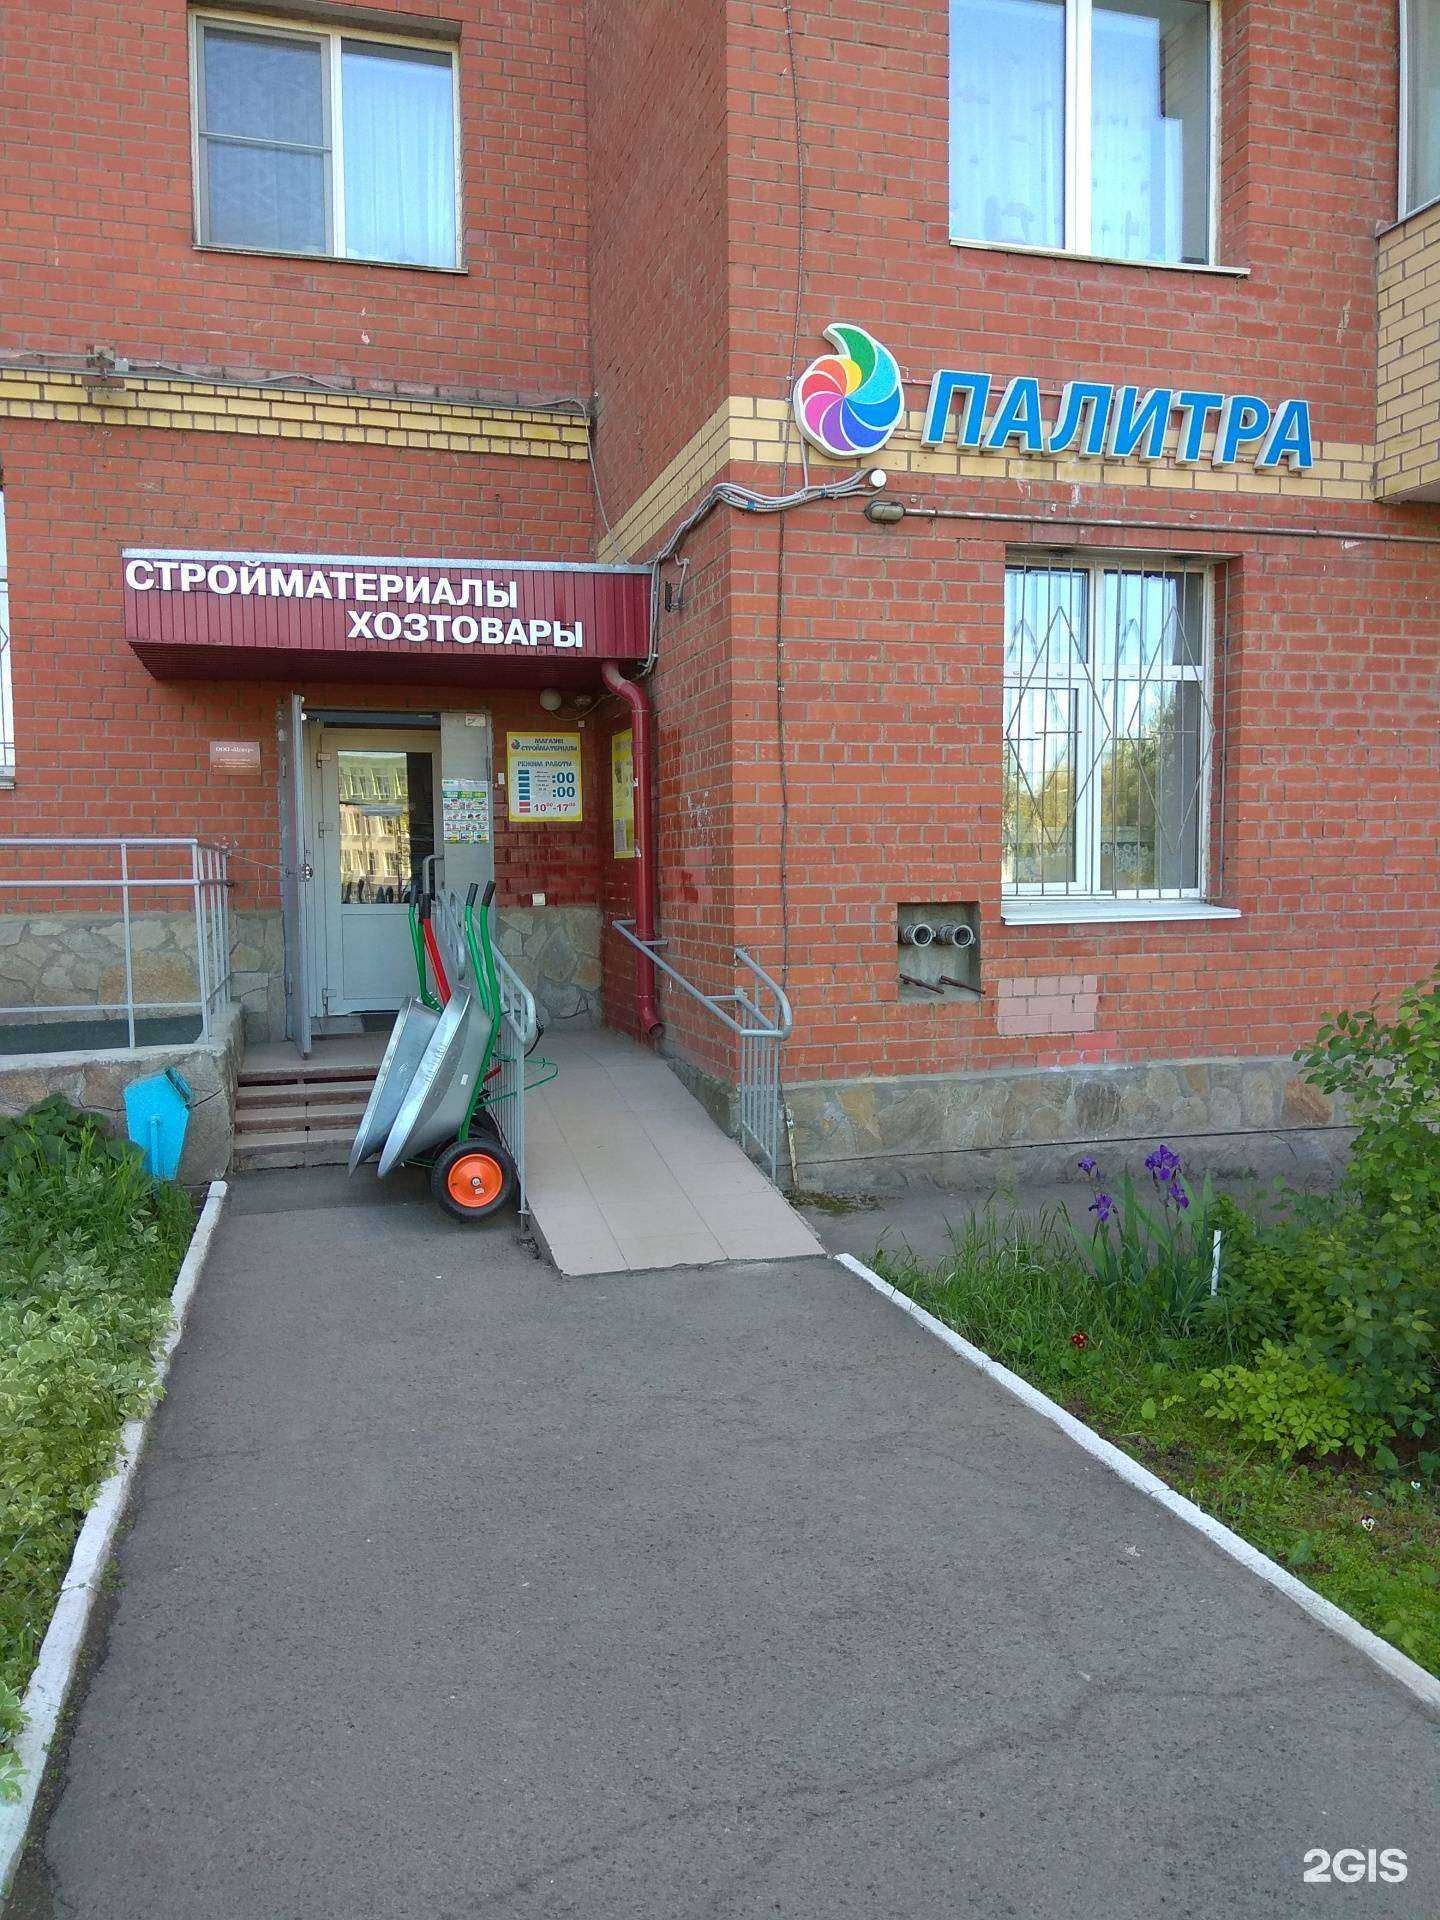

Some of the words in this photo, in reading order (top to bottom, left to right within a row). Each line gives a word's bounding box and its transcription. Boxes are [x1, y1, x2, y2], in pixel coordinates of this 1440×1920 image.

[922, 369, 1312, 469] ПАЛИТРА
[125, 559, 517, 608] СТРОЙМАТЕРИАЛЫ
[347, 610, 583, 648] ХОЗТОВАРЫ
